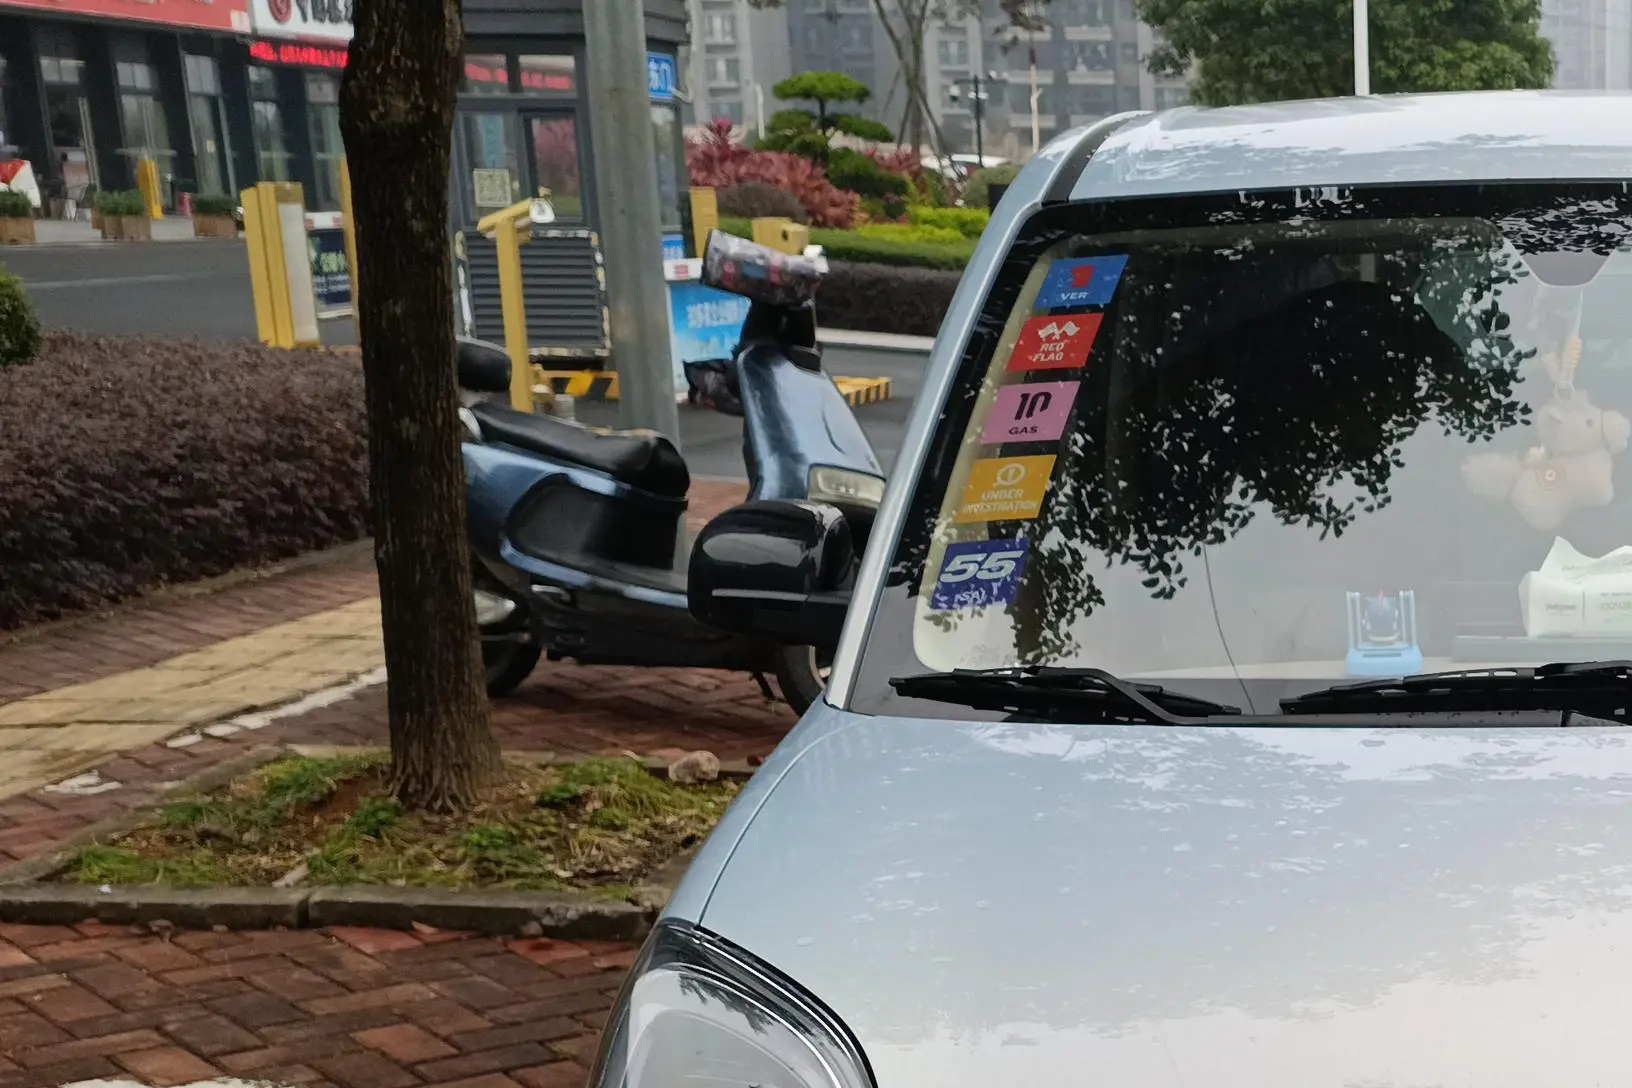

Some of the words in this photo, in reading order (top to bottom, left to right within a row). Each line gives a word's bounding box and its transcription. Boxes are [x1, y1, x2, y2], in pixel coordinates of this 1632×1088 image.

[1040, 342, 1065, 351] RED
[1032, 352, 1065, 362] FLAG
[1008, 426, 1038, 435] GAS
[981, 489, 1024, 501] UNDER
[940, 551, 1024, 583] 55
